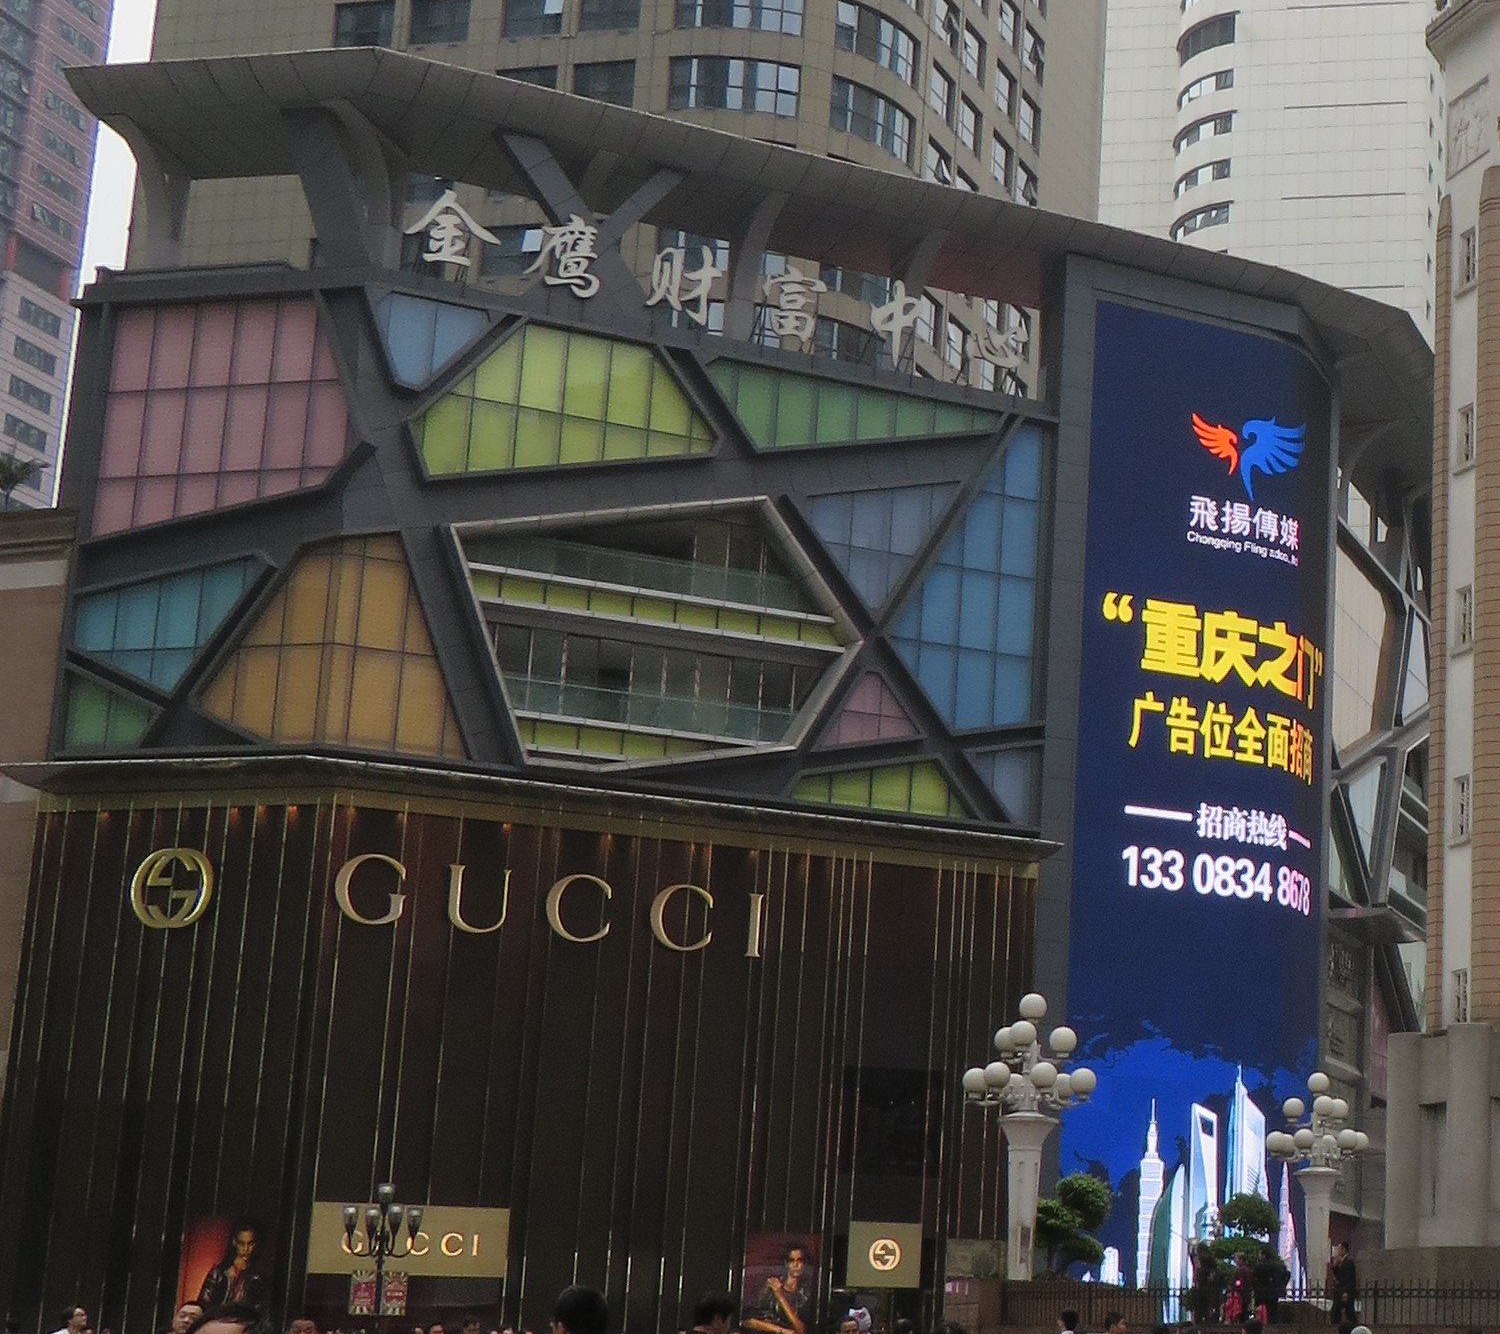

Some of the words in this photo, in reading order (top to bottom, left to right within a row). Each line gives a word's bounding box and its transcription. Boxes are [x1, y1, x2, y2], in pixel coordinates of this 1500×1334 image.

[1128, 690, 1314, 787] 广告位全面招商
[334, 852, 767, 959] GUCCI
[1121, 845, 1186, 892] 133
[1192, 852, 1273, 903] 0834
[1277, 866, 1312, 917] 8678
[341, 1230, 481, 1258] GCCI
